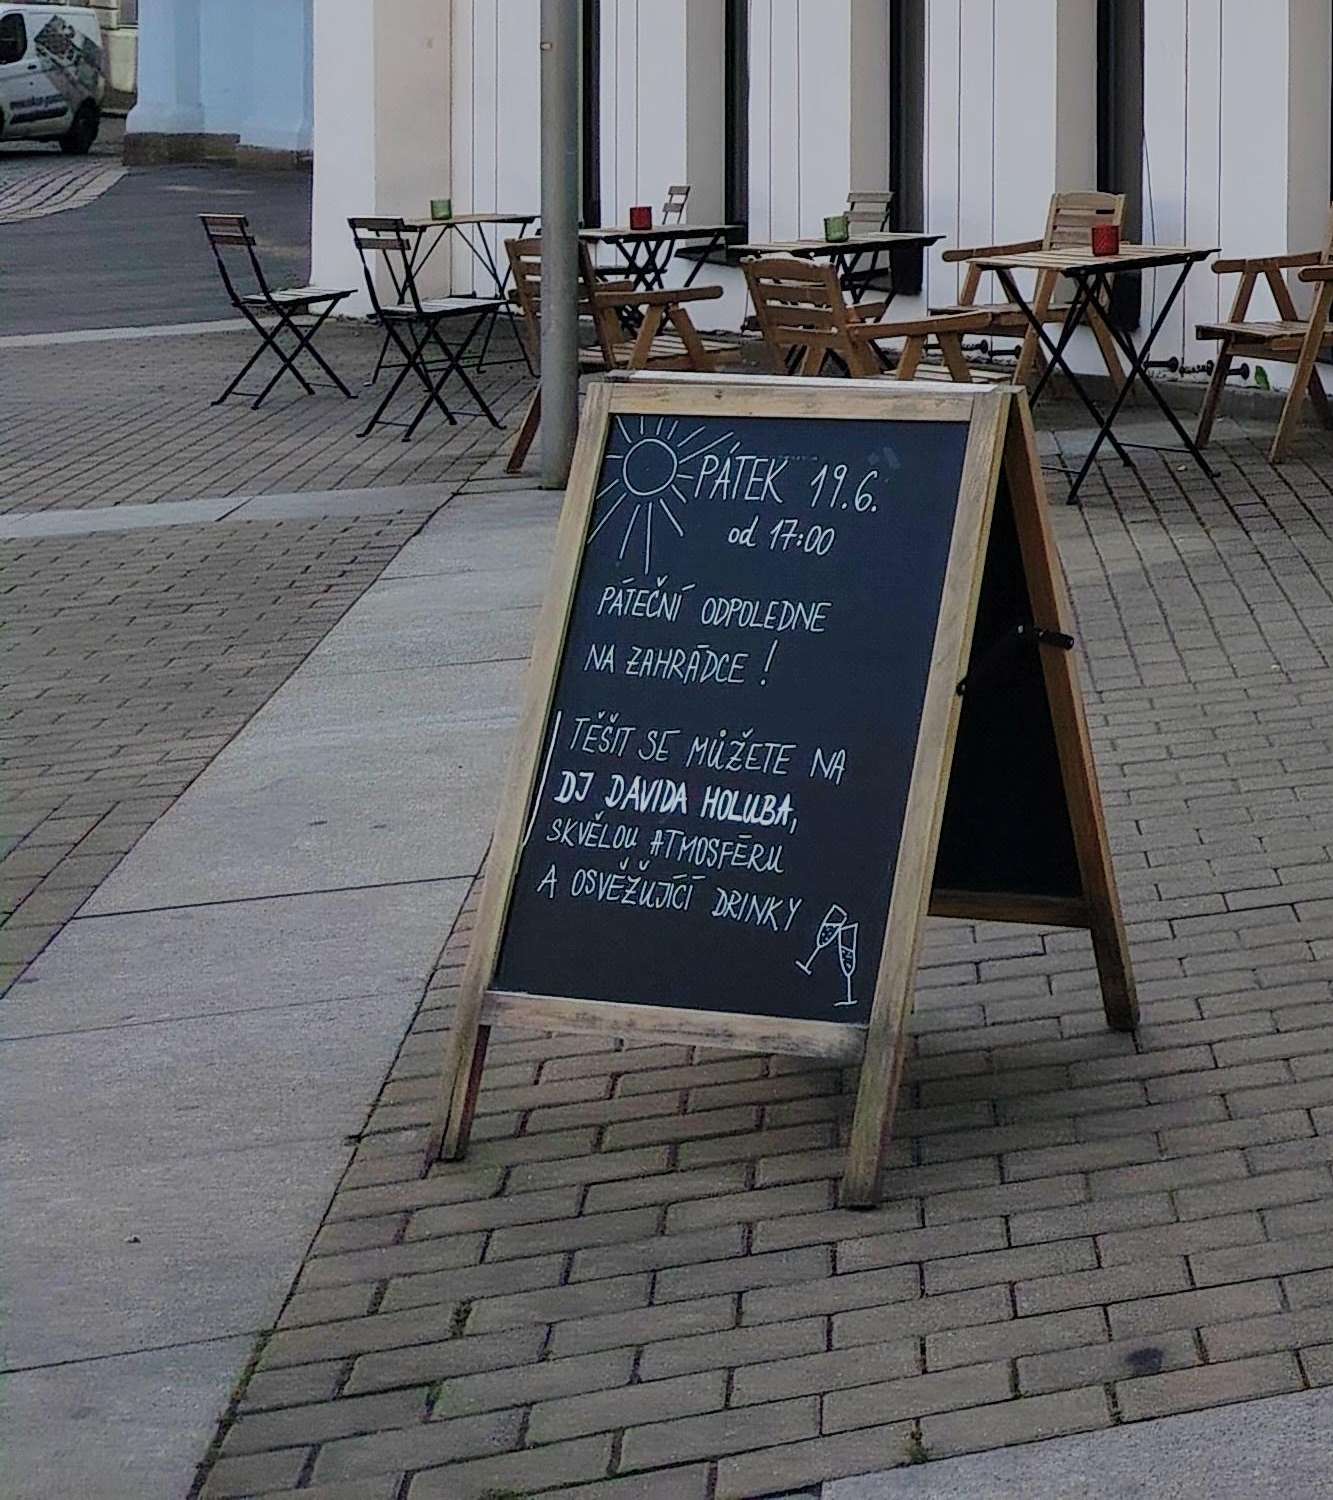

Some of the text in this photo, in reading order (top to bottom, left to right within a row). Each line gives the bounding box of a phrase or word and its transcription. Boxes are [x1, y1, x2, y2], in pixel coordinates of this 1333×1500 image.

[694, 442, 879, 514] PÁTEK 19.6.
[727, 515, 836, 556] od 17:00
[597, 575, 833, 633] PÁTEČNÍ ODPOLEDNE
[583, 643, 616, 673] NA
[625, 644, 749, 685] ZAHRÁDCE
[570, 710, 847, 786] TĚŠIT SE MŮŽETE NA
[554, 770, 798, 835] DJ DAVIDA HOLUBA,
[546, 810, 784, 874] SKVĚLOU ATMOSFÉRU
[536, 856, 802, 932] A OSVĚŽUJÍCÍ DRINKY
